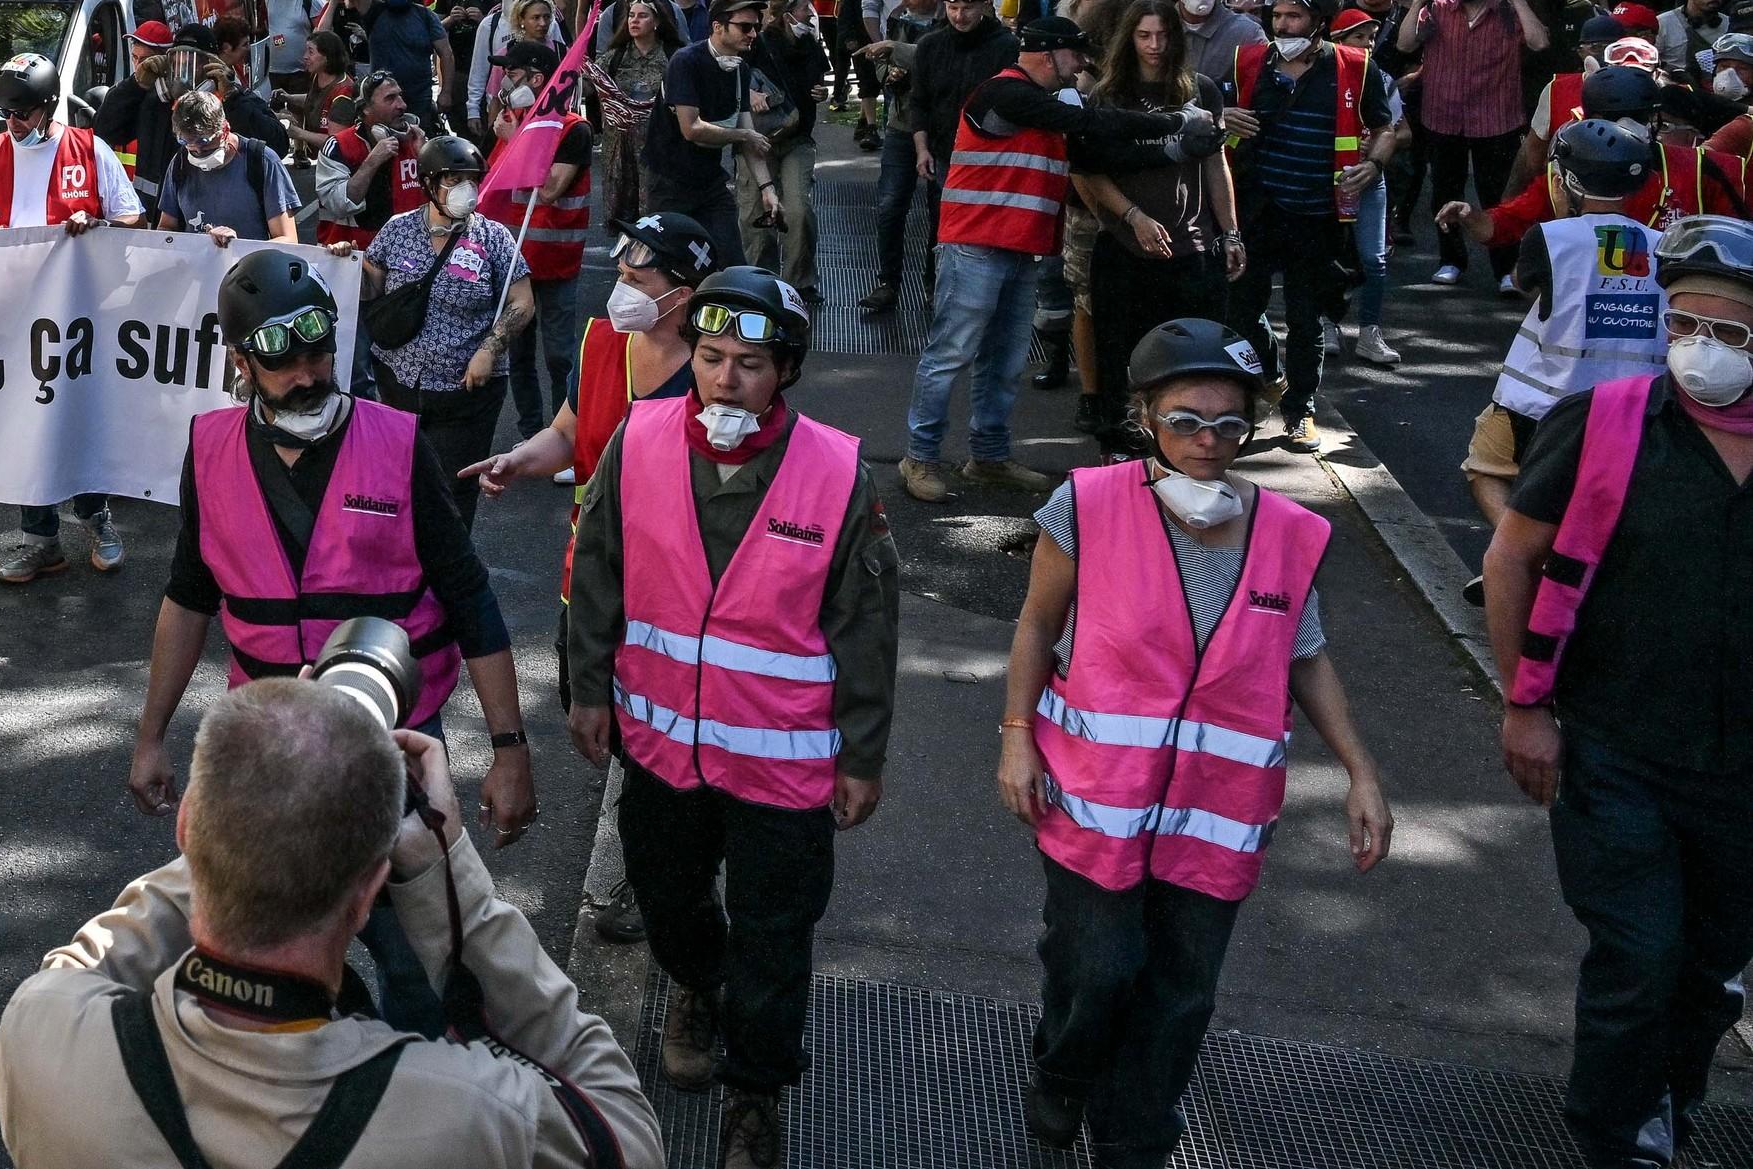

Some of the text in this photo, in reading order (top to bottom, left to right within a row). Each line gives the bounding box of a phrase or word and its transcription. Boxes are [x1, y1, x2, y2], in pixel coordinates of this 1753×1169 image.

[61, 164, 87, 190] FO
[399, 158, 418, 181] FO
[61, 189, 90, 200] RHÔNE
[1598, 277, 1649, 292] F.S.U.
[1602, 317, 1656, 329] QUOTIDIE
[29, 315, 93, 405] ça
[344, 493, 399, 514] Solidaires
[768, 518, 825, 543] Solidaires
[186, 955, 274, 1008] Canon
